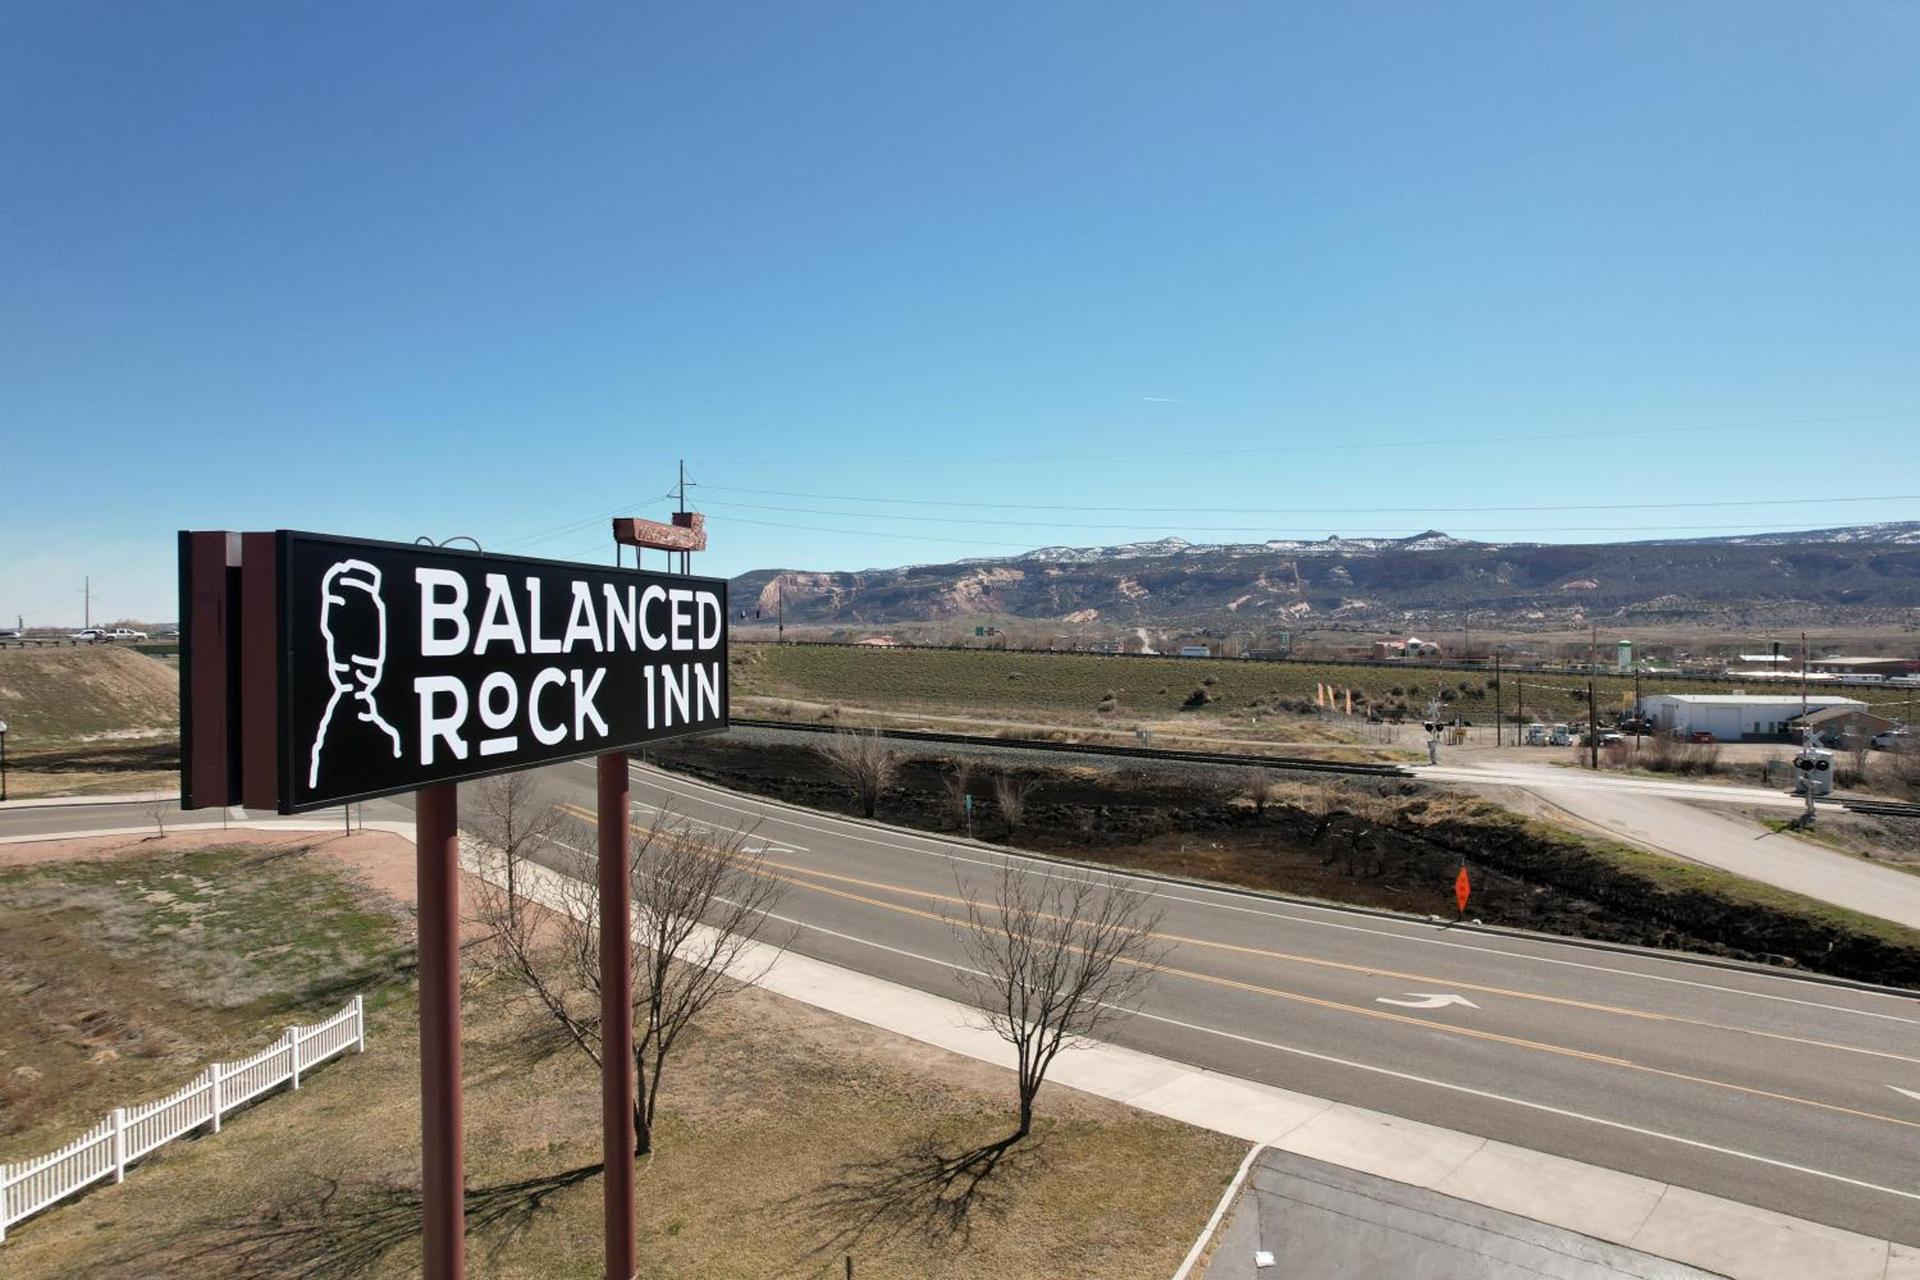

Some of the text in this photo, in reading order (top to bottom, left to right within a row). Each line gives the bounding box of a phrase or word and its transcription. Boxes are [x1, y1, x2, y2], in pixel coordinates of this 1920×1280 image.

[415, 567, 722, 657] BALANCED
[413, 661, 720, 766] ROCK INN
